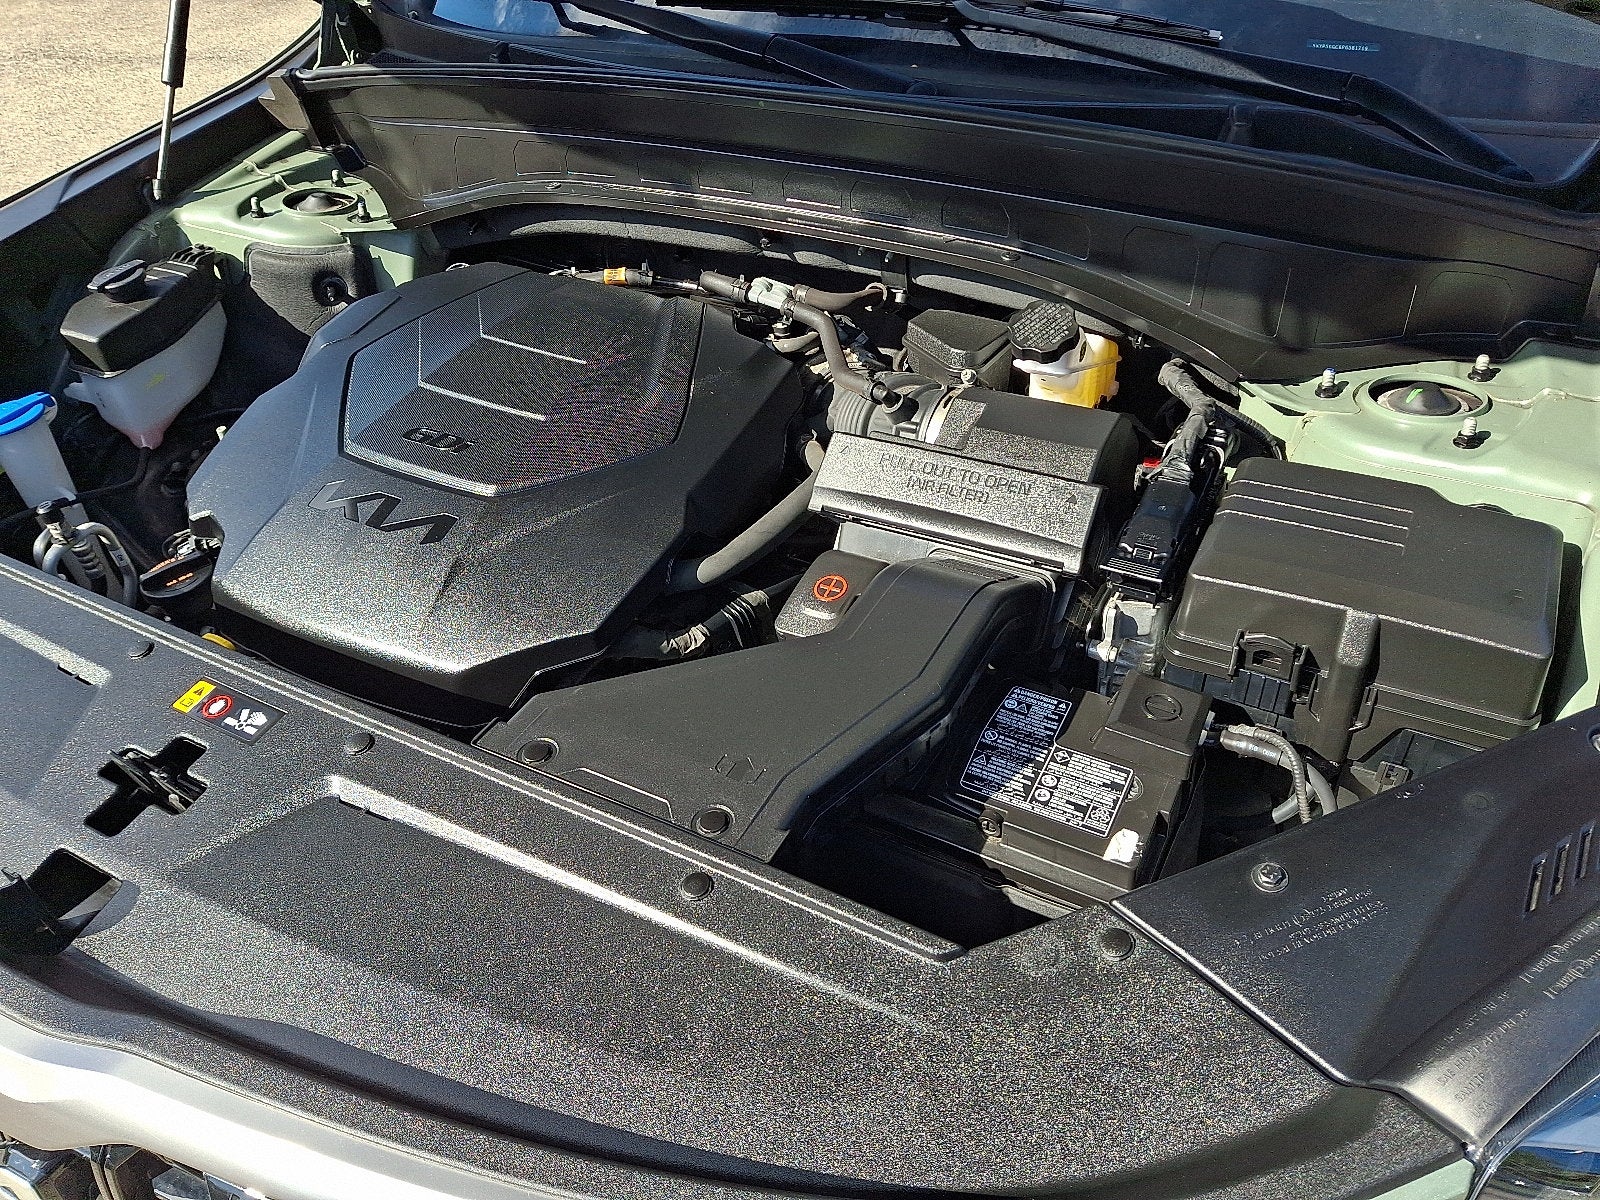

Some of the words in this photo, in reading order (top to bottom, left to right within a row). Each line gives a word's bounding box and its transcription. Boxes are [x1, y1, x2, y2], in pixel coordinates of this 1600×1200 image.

[879, 452, 917, 473] PULL
[922, 461, 957, 480] OUT
[959, 468, 982, 486] TO
[984, 474, 1032, 496] OPEN
[308, 479, 460, 545] KIA
